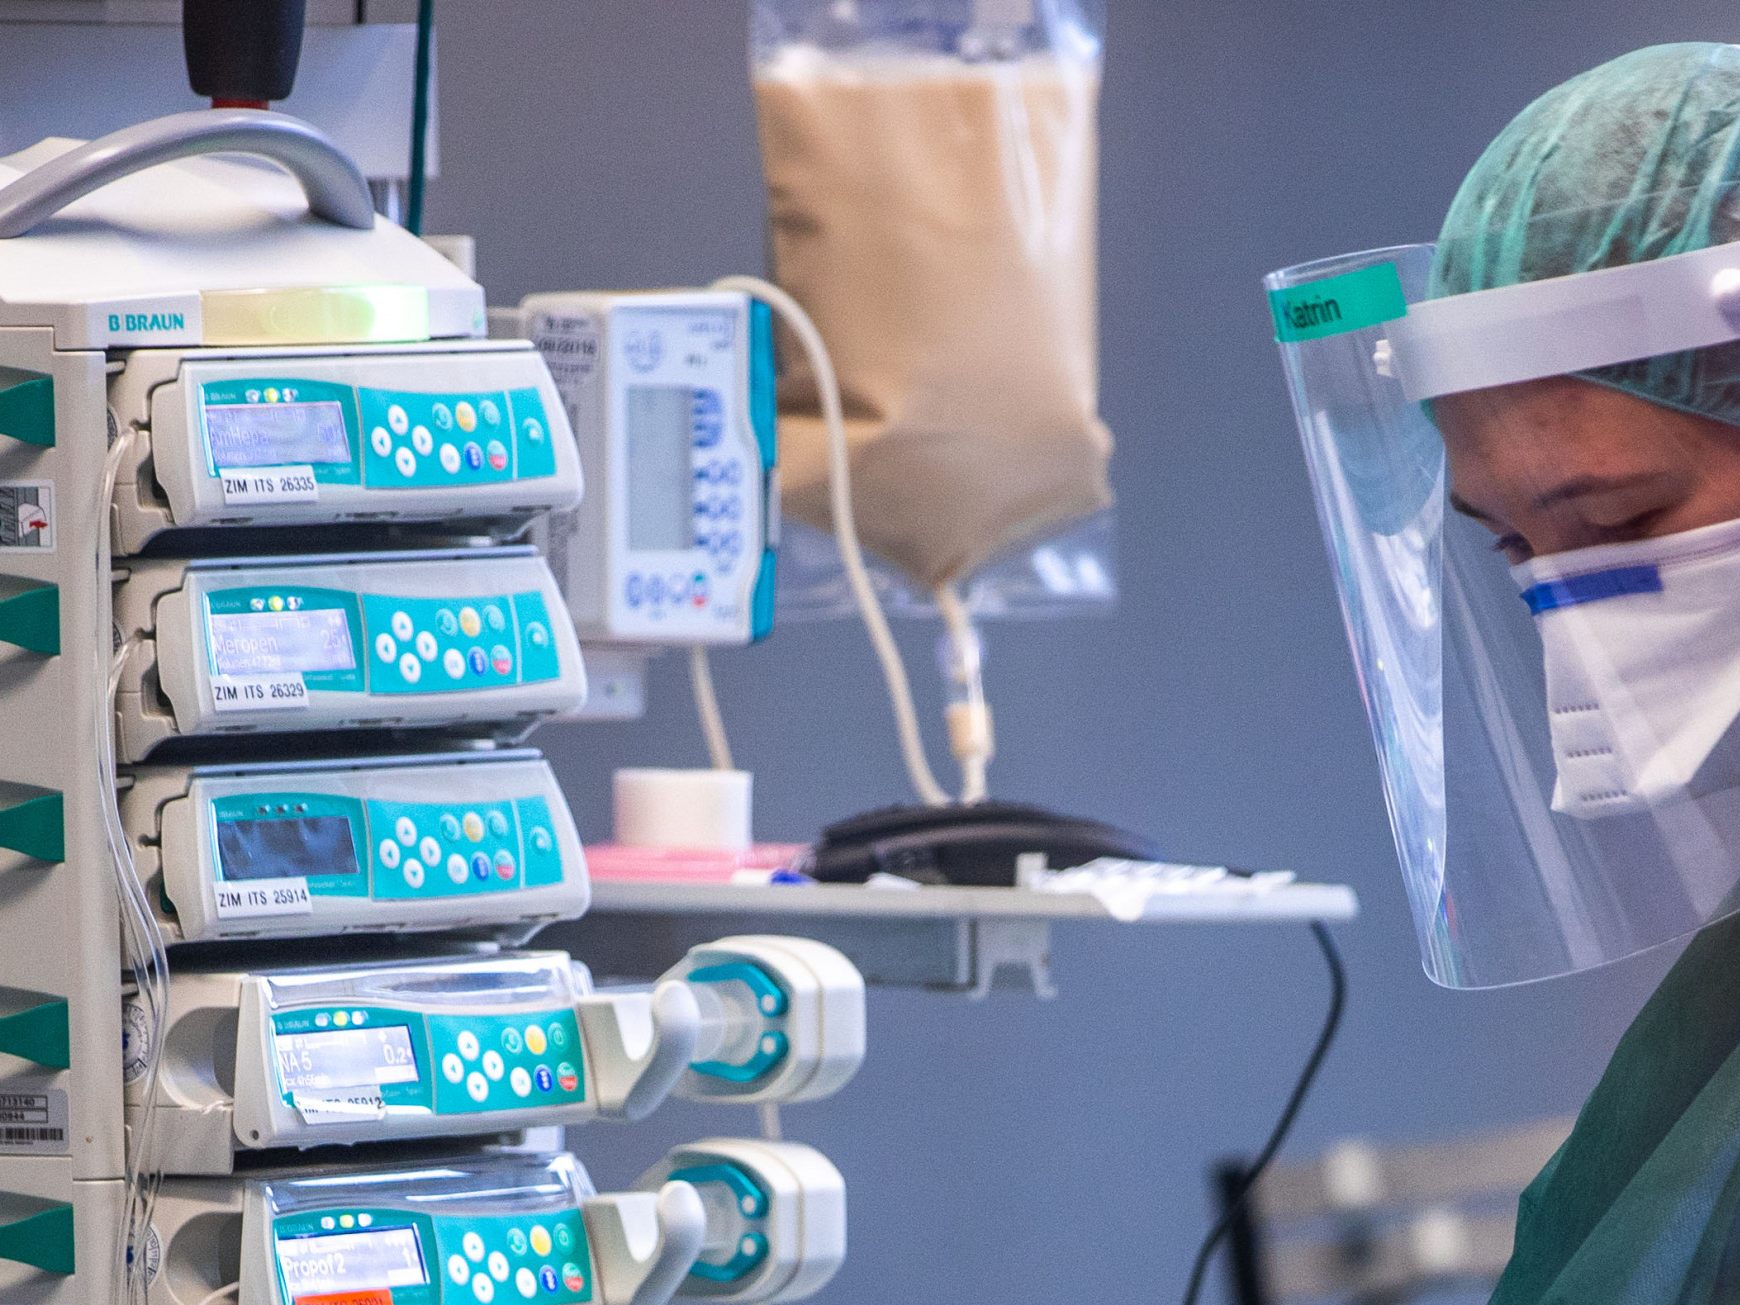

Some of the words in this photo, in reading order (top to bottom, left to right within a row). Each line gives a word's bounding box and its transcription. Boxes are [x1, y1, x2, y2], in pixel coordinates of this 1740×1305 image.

[1283, 296, 1343, 329] Katrin
[108, 314, 120, 332] B
[125, 313, 184, 332] BRAUN
[224, 479, 248, 494] ZIM
[255, 478, 275, 493] ITS
[280, 476, 315, 491] 26335
[214, 685, 238, 701] ZIM
[245, 684, 264, 699] ITS
[271, 682, 305, 698] 26329
[218, 893, 242, 908] ZIM
[248, 891, 267, 906] ITS
[274, 889, 308, 904] 25914
[280, 1052, 301, 1073] NA
[301, 1050, 313, 1071] 5
